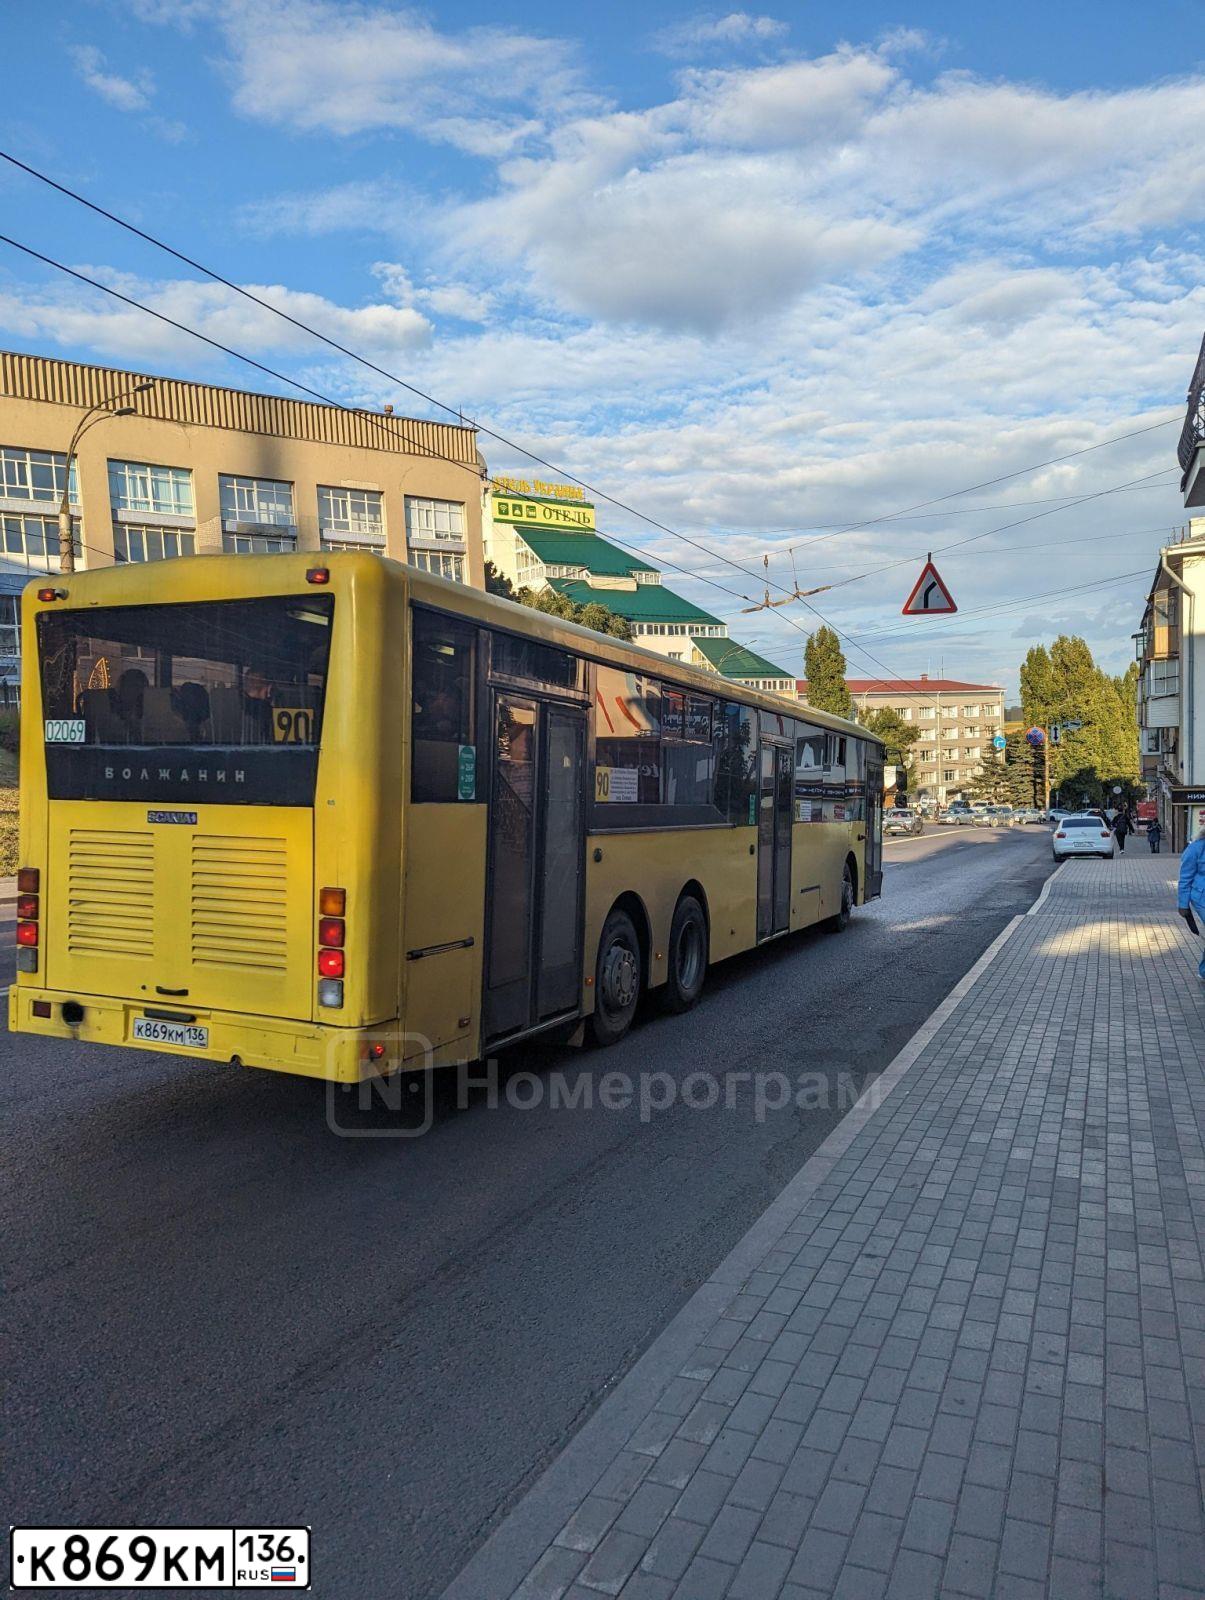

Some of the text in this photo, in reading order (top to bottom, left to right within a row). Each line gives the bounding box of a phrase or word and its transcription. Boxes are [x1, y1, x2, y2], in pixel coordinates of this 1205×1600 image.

[542, 506, 591, 524] ОТЕЛЬ
[46, 721, 84, 741] 02069
[277, 710, 311, 743] 90
[104, 766, 245, 783] ВОЛЖАНИН
[596, 771, 609, 797] 90
[186, 1027, 205, 1041] 136
